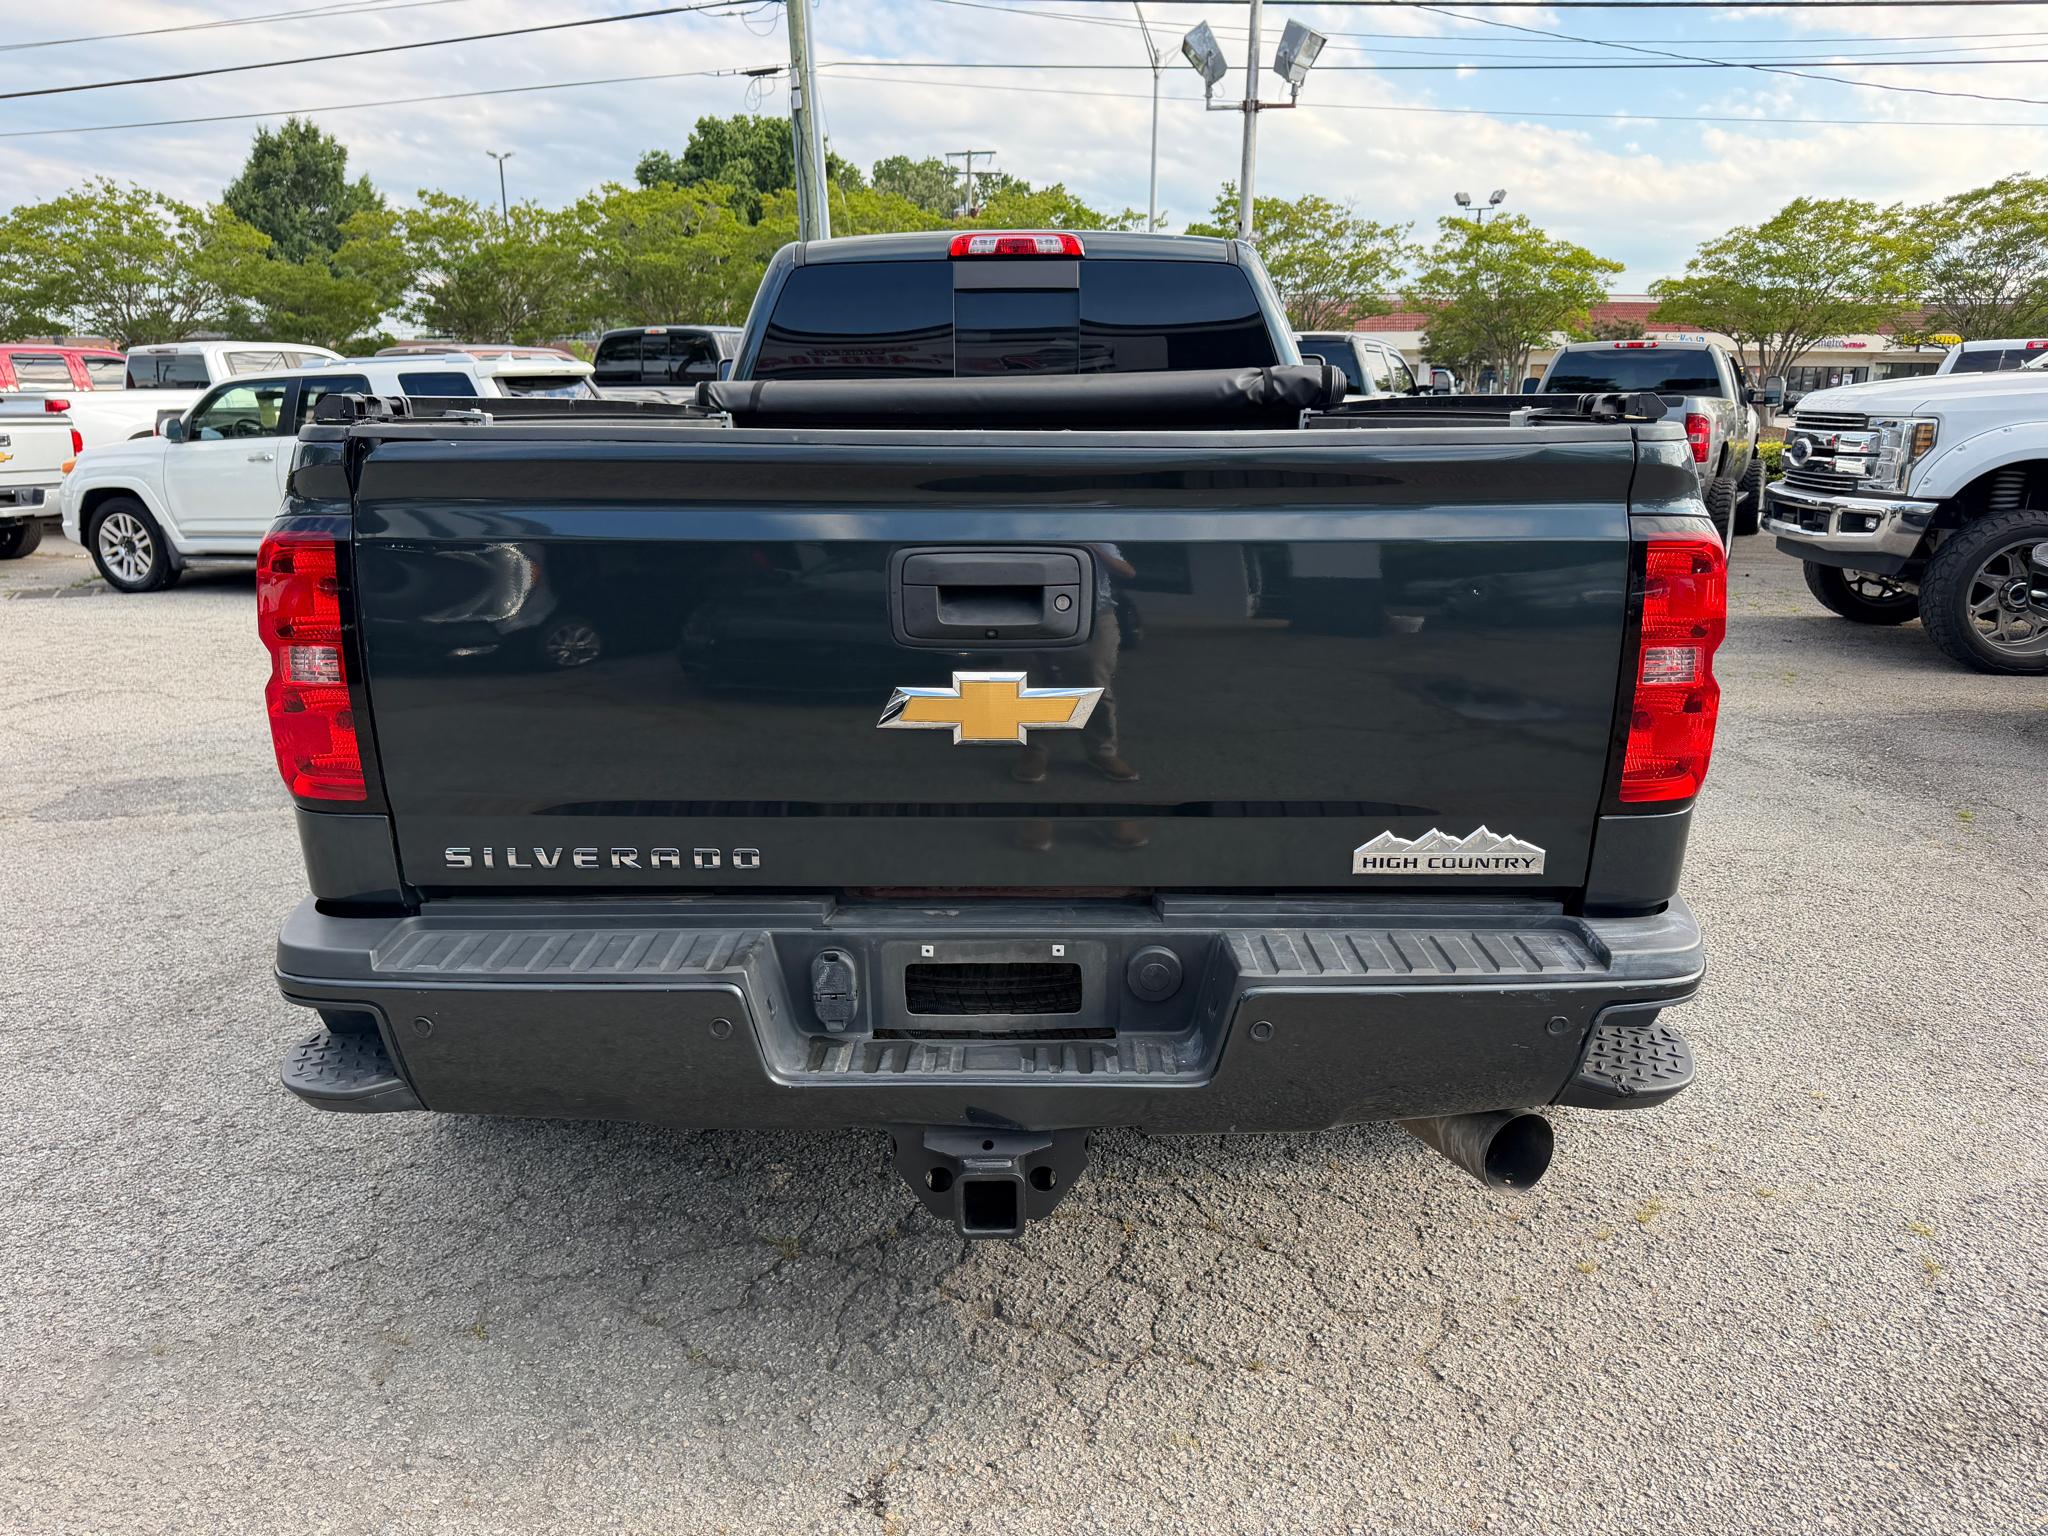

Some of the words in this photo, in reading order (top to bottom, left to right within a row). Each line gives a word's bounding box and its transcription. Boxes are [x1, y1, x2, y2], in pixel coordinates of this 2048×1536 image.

[445, 847, 761, 869] SILVERADO
[1362, 857, 1418, 869] HIGH
[1427, 857, 1536, 869] COUNTRY
